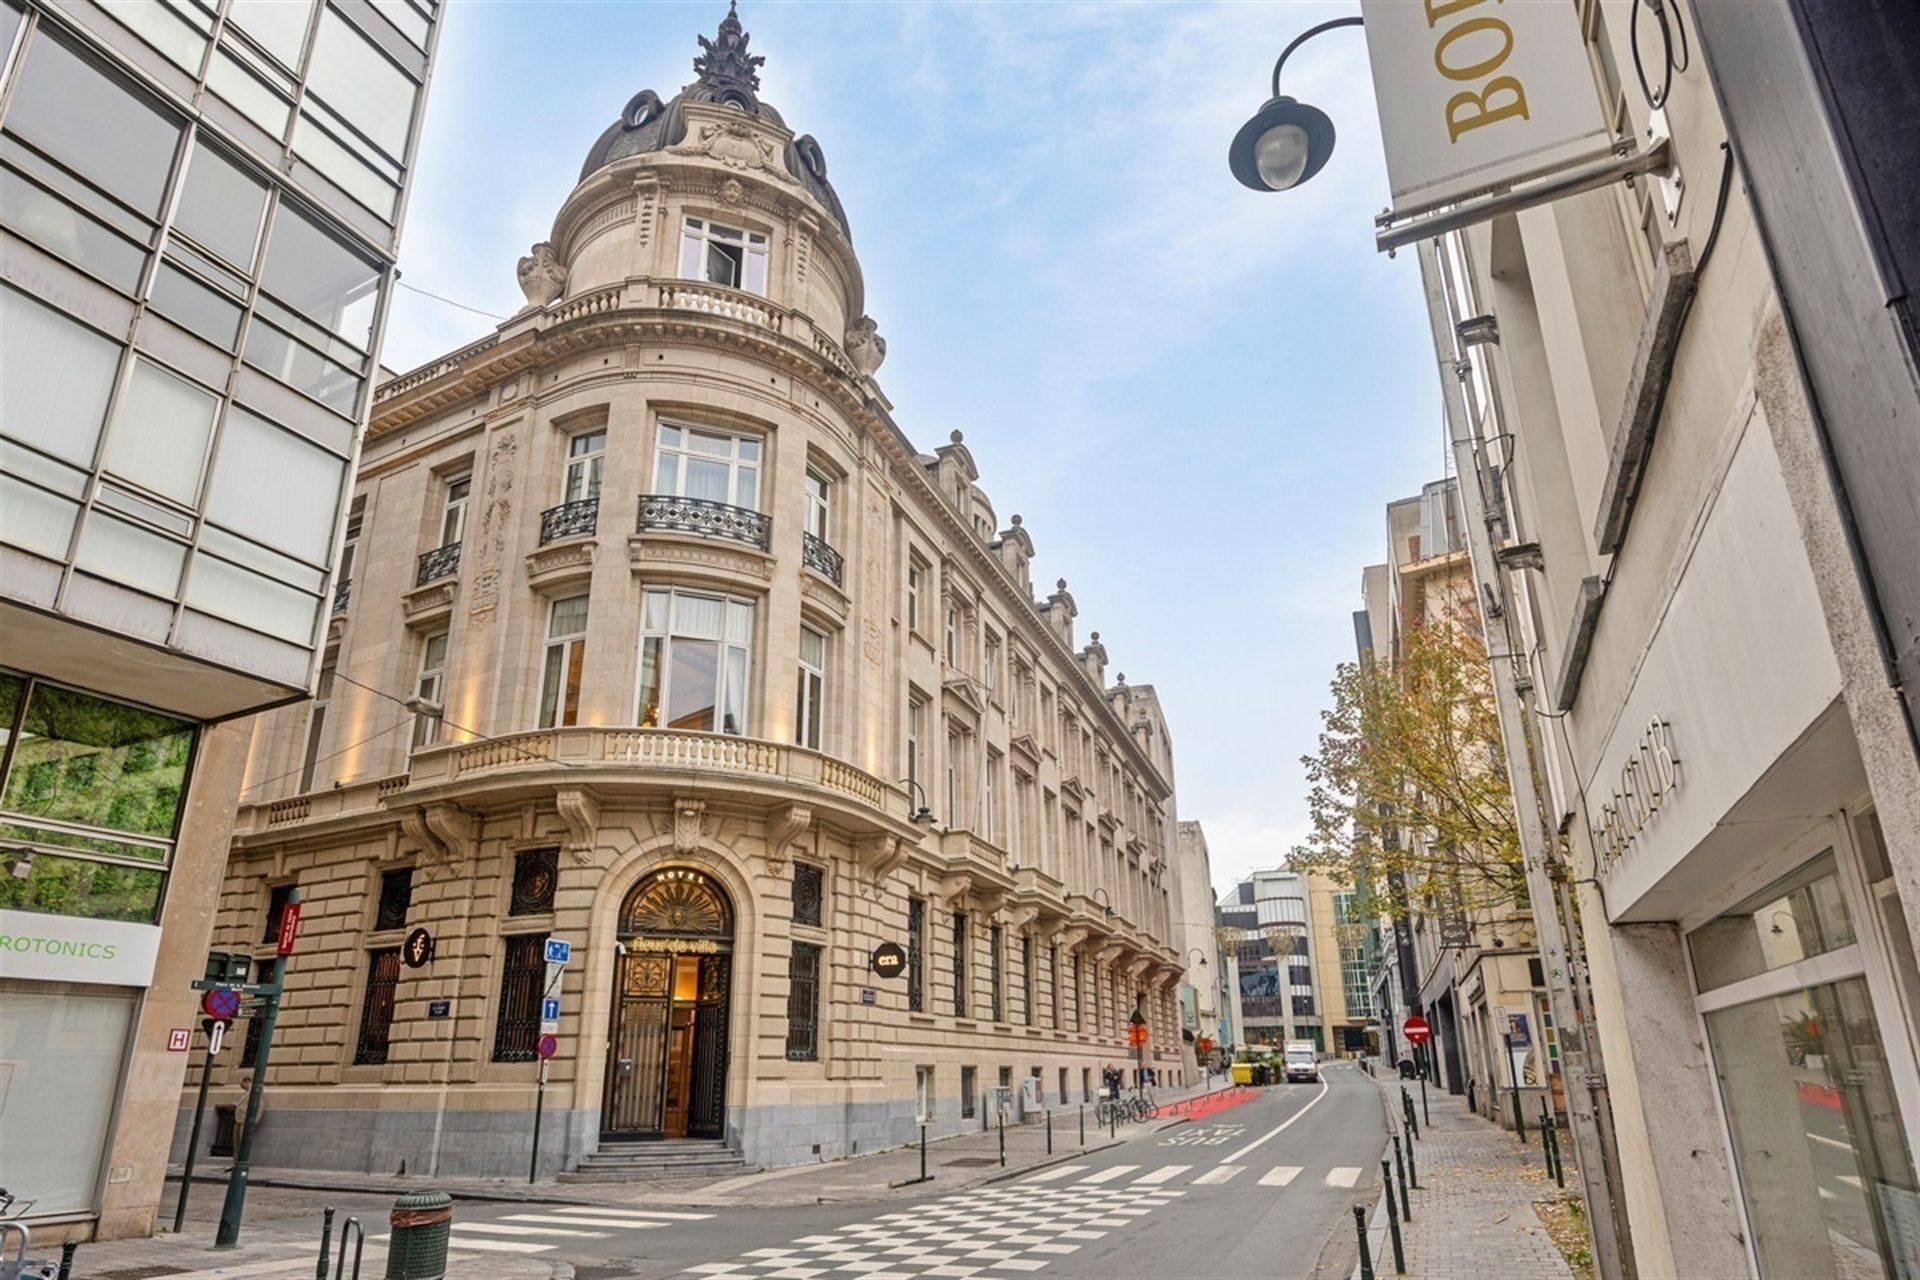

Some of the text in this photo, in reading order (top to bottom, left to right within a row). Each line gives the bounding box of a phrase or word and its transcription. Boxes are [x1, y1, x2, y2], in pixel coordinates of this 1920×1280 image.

[172, 1033, 185, 1047] H
[1176, 1128, 1247, 1136] TAXI
[1157, 1137, 1230, 1146] BUS
